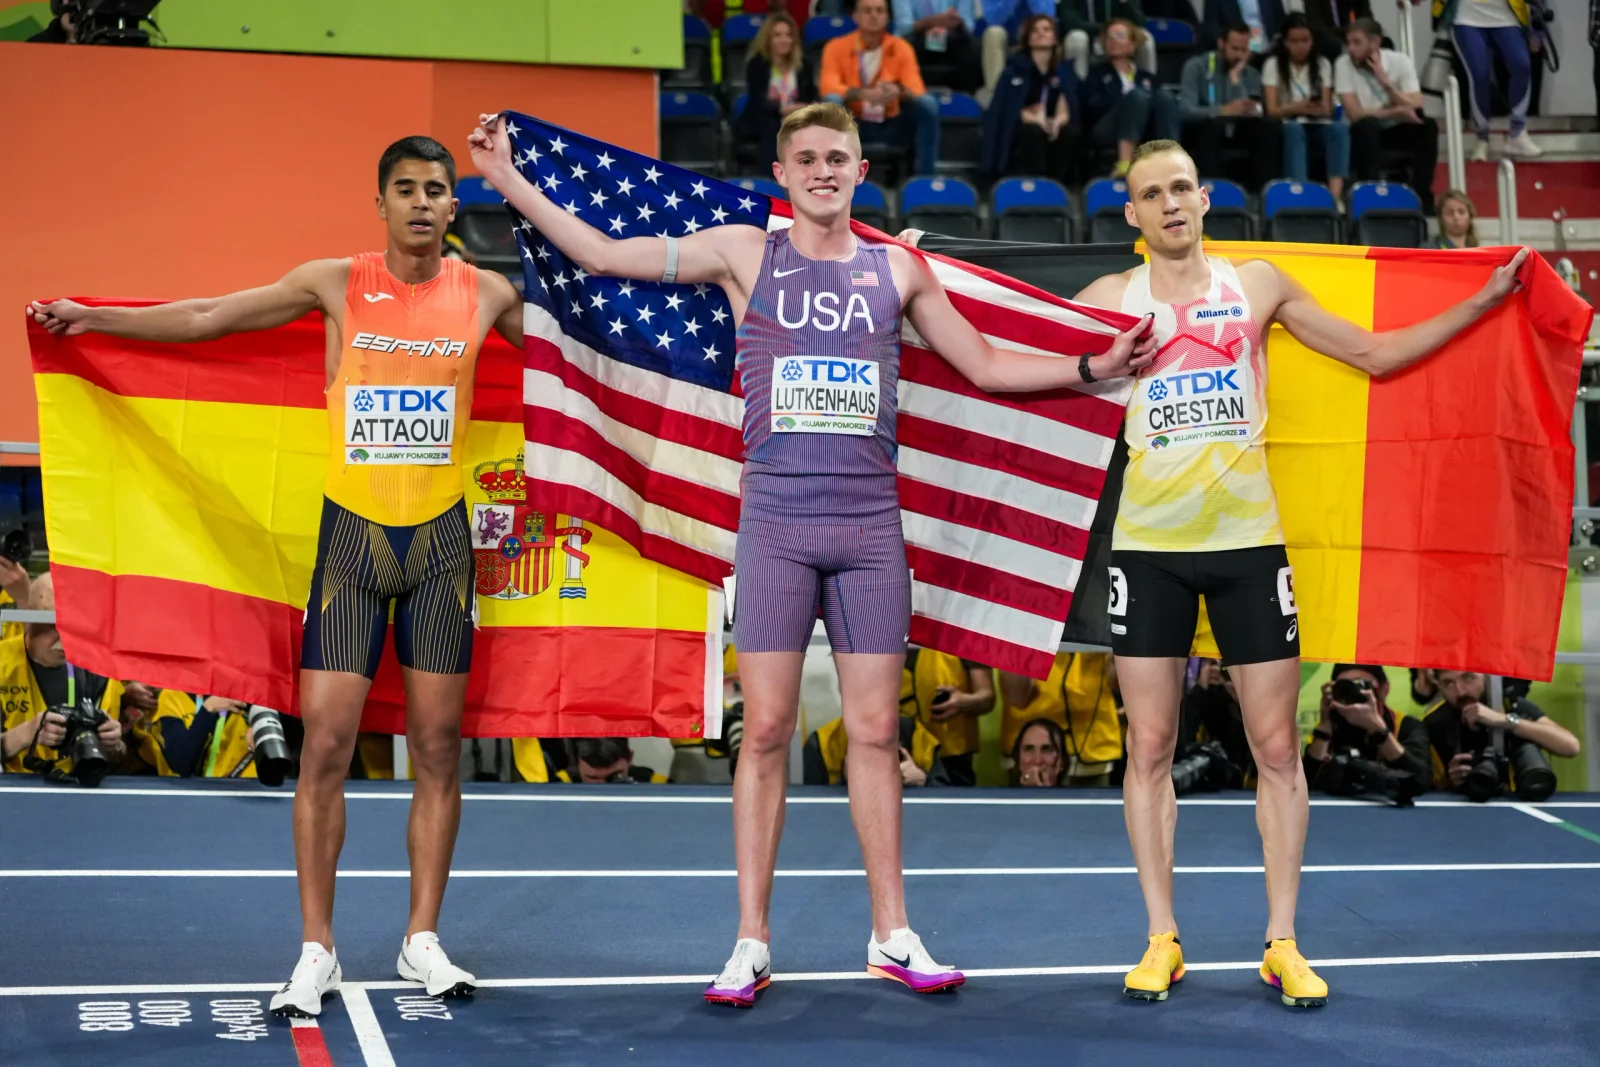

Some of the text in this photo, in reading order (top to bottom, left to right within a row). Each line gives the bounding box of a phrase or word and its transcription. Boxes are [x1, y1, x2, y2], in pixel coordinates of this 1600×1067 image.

[777, 289, 875, 333] USA
[1196, 309, 1229, 319] Allianz
[351, 332, 467, 357] ESPAÑA
[803, 360, 872, 386] TDK
[1166, 369, 1240, 396] TDK
[374, 389, 448, 412] TDK
[775, 387, 876, 415] LUTKENHAUS
[1149, 396, 1244, 430] CRESTAN
[351, 418, 449, 442] ATTAOUI
[801, 420, 831, 428] KUJAWY
[832, 421, 866, 430] POMORZE
[1173, 433, 1203, 442] KUJAWY
[1204, 430, 1238, 438] POMORZE
[1111, 575, 1119, 608] 5
[78, 1001, 134, 1031] 800
[138, 999, 192, 1026] 400
[209, 999, 269, 1041] 4x400
[393, 995, 453, 1020] 200
